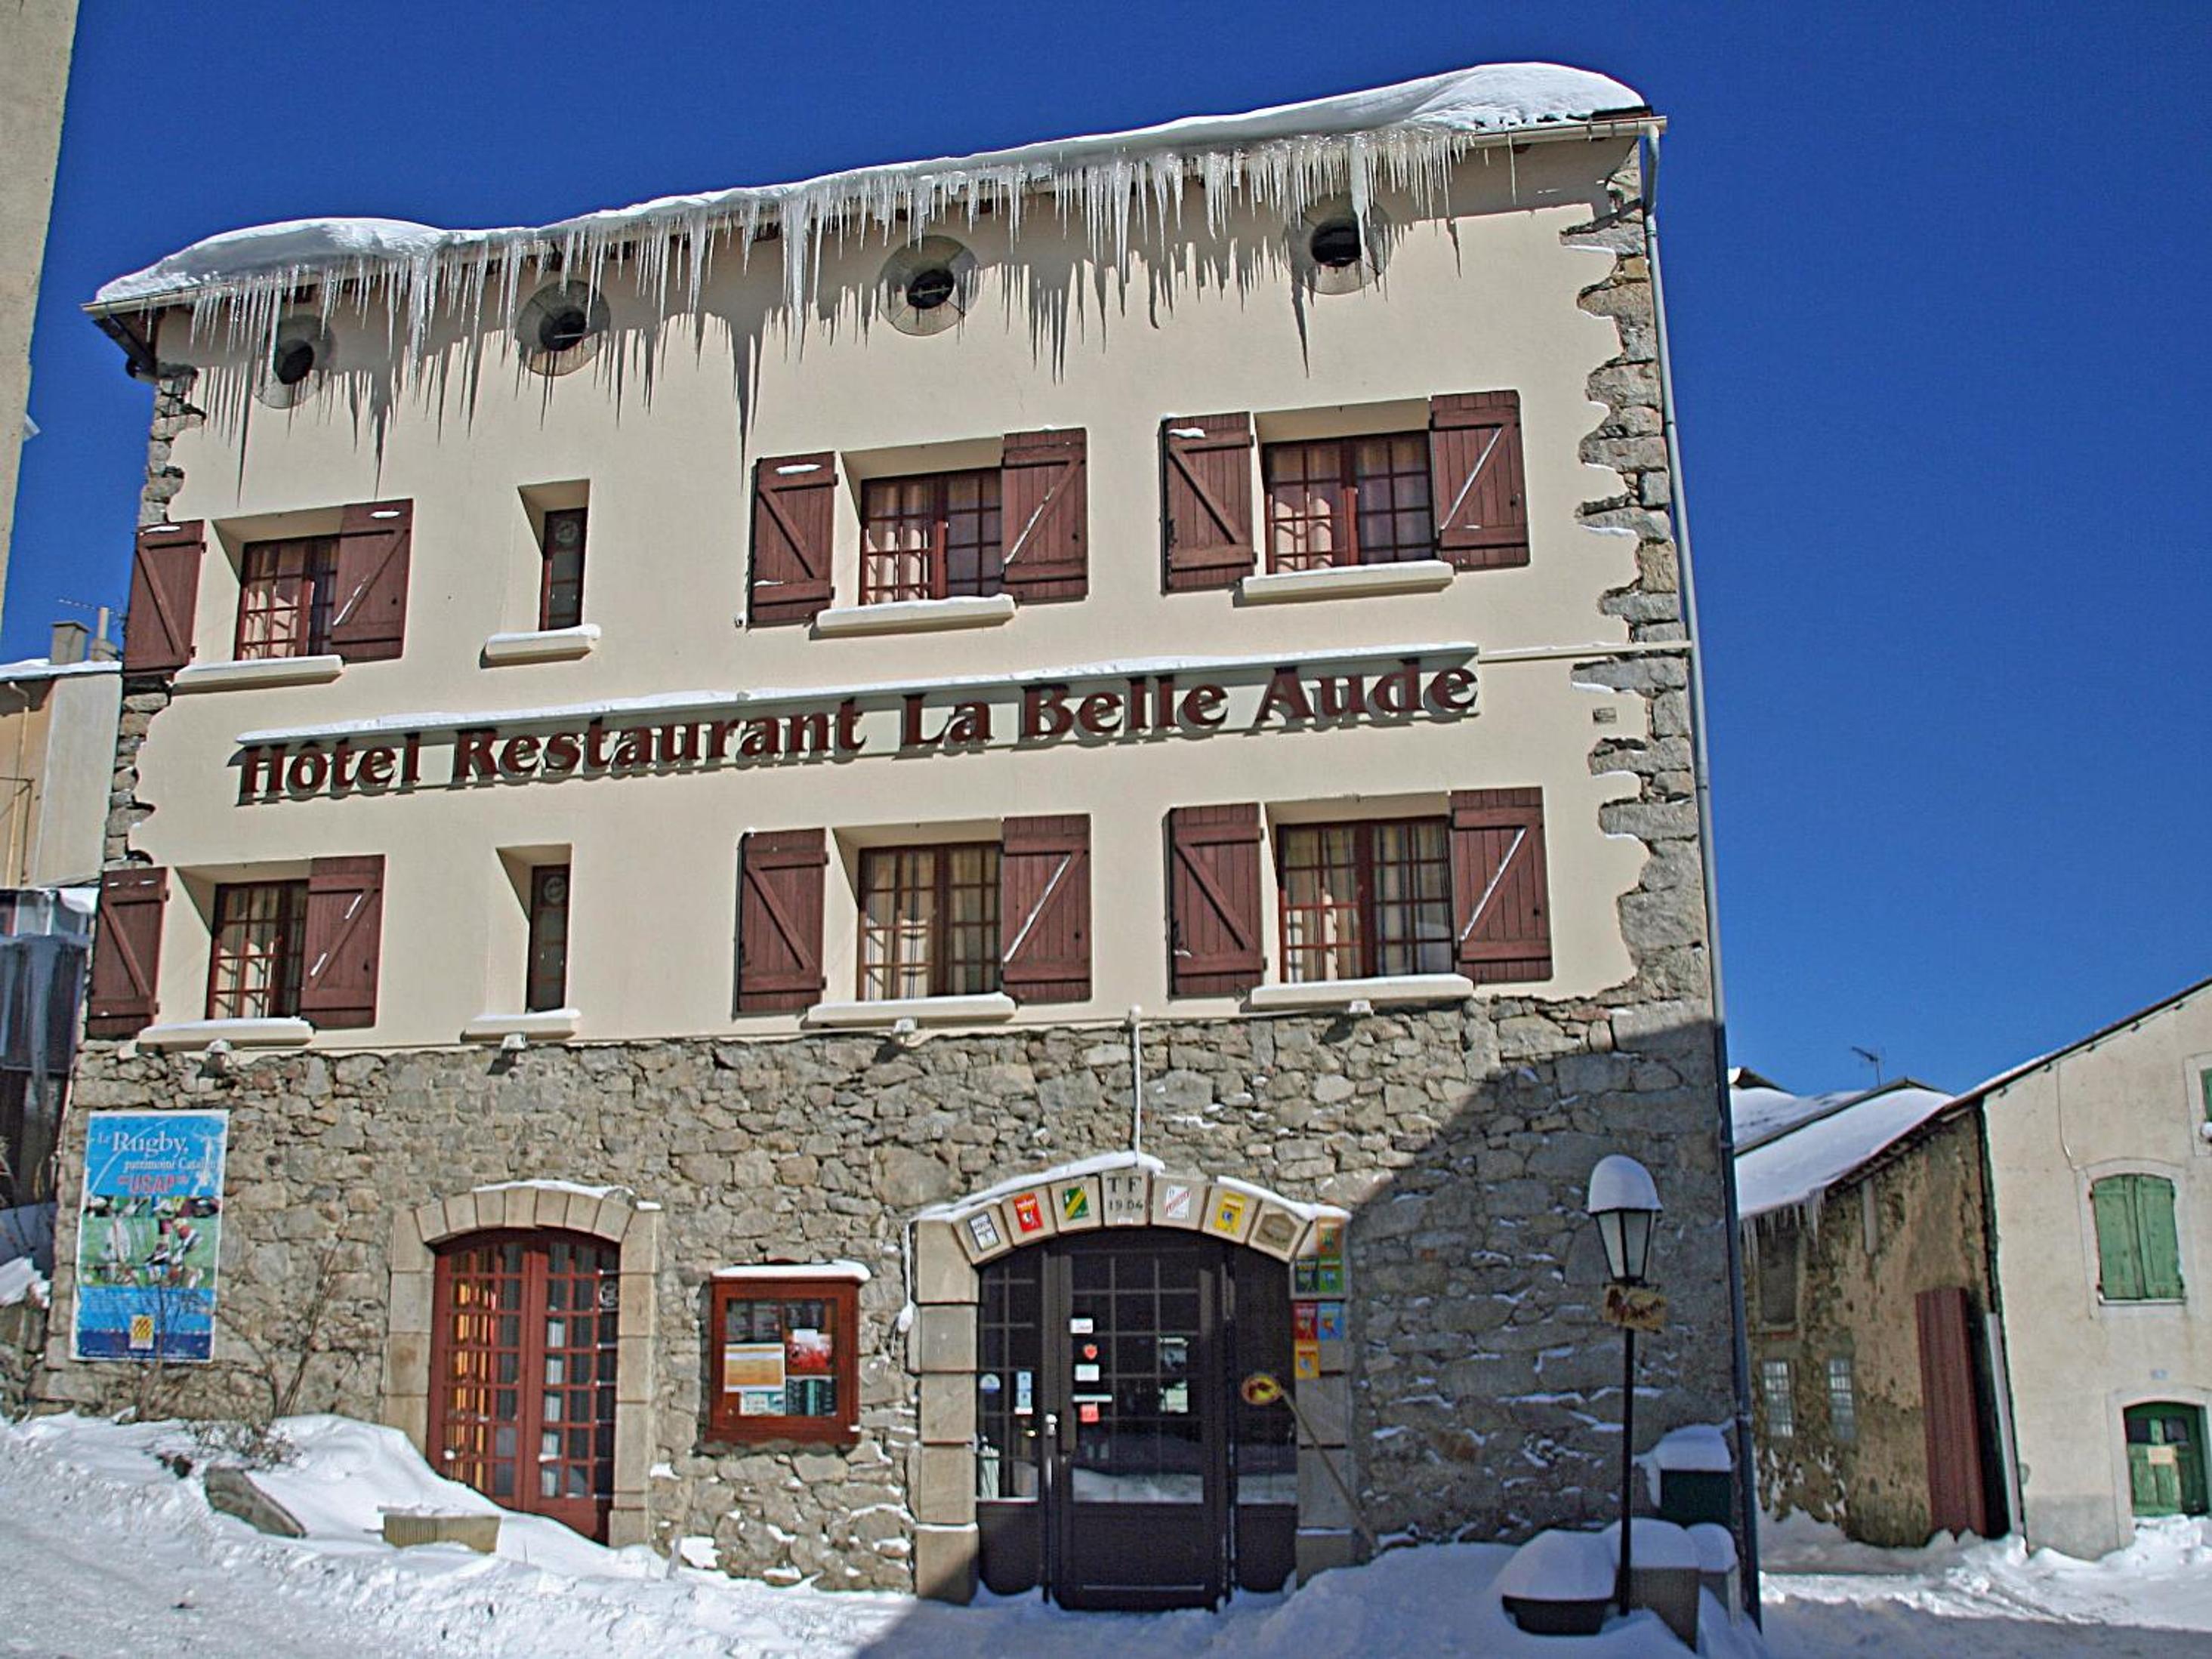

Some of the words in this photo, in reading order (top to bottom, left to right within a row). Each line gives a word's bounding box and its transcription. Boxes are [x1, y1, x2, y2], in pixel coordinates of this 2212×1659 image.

[455, 698, 866, 779] Restaurant
[902, 693, 991, 746] La
[1023, 674, 1229, 738] Belle
[1254, 658, 1478, 723] Aude
